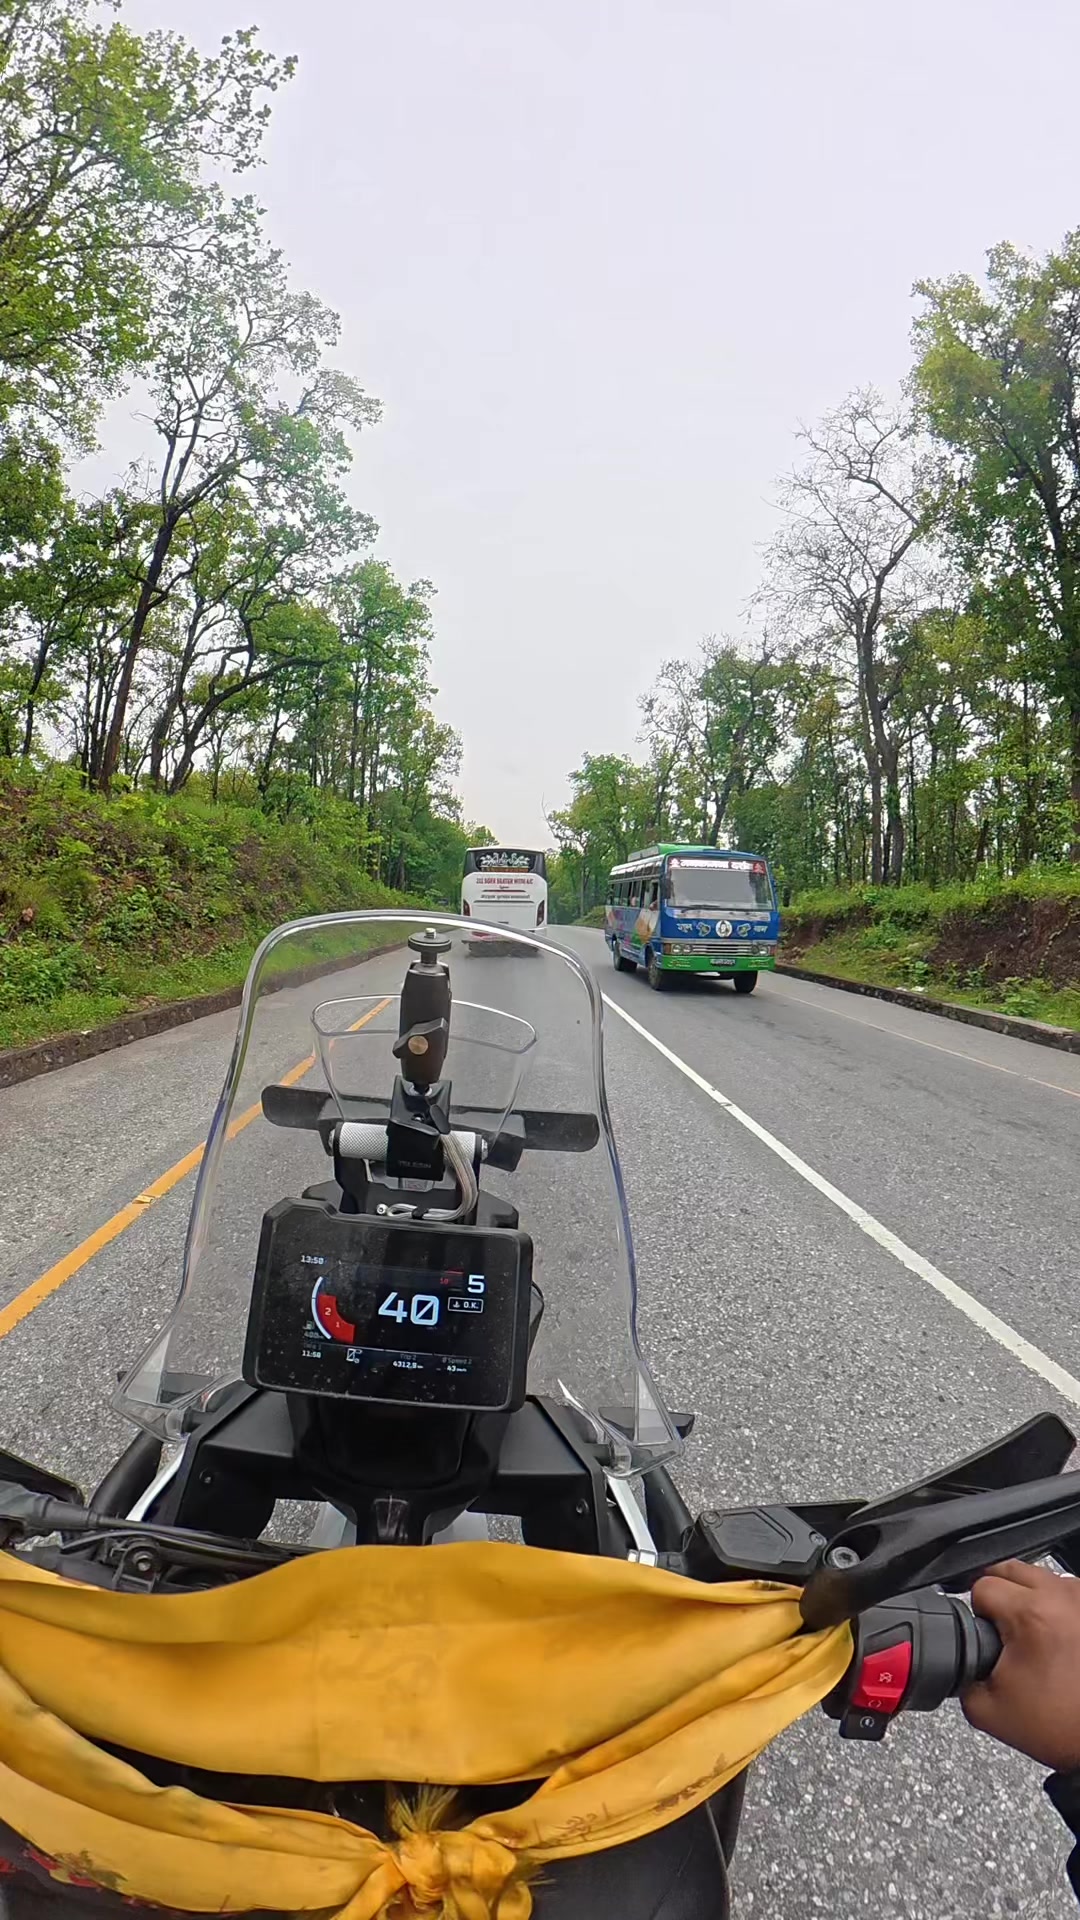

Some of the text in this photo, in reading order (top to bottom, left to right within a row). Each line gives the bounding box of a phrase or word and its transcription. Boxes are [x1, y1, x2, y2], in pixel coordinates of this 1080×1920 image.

[300, 1254, 325, 1265] 13:50
[467, 1274, 486, 1294] 5
[324, 1307, 332, 1316] 2
[378, 1291, 440, 1326] 40
[335, 1321, 341, 1329] 1
